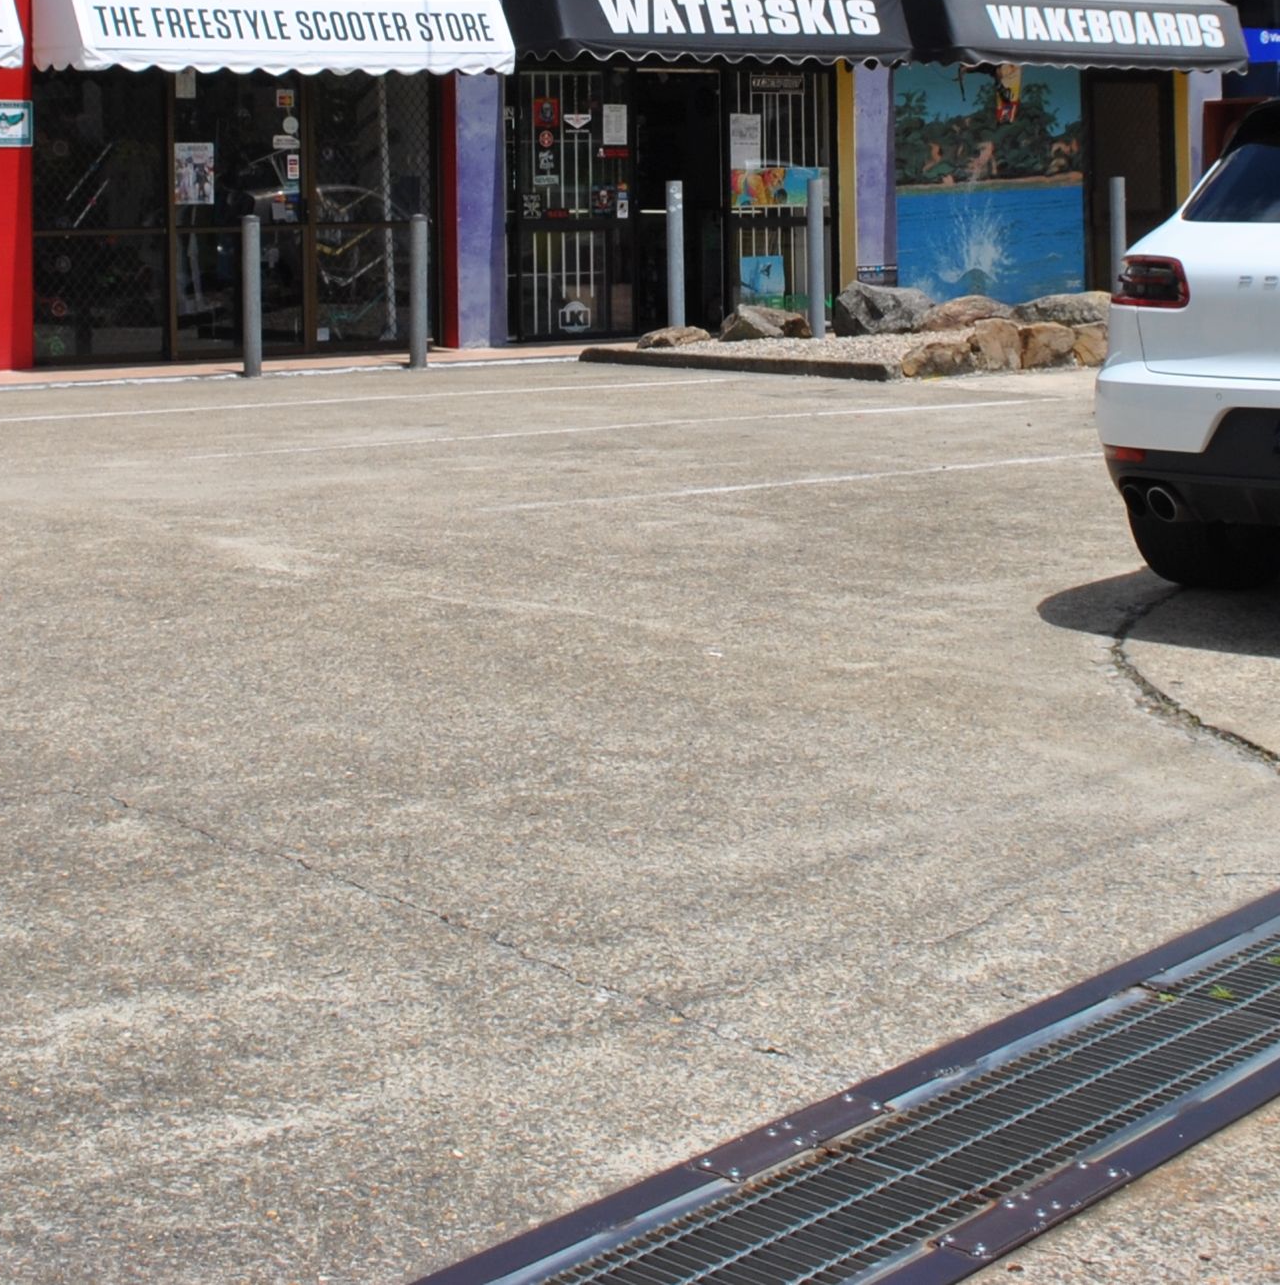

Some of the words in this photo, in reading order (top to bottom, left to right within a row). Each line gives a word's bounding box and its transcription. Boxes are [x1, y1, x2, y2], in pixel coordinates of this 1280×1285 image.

[93, 5, 147, 37] THE
[153, 6, 291, 41] FREESTYLE
[297, 10, 412, 43] SCOOTER
[416, 12, 494, 43] STORE
[985, 3, 1225, 49] WAKEBOARDS
